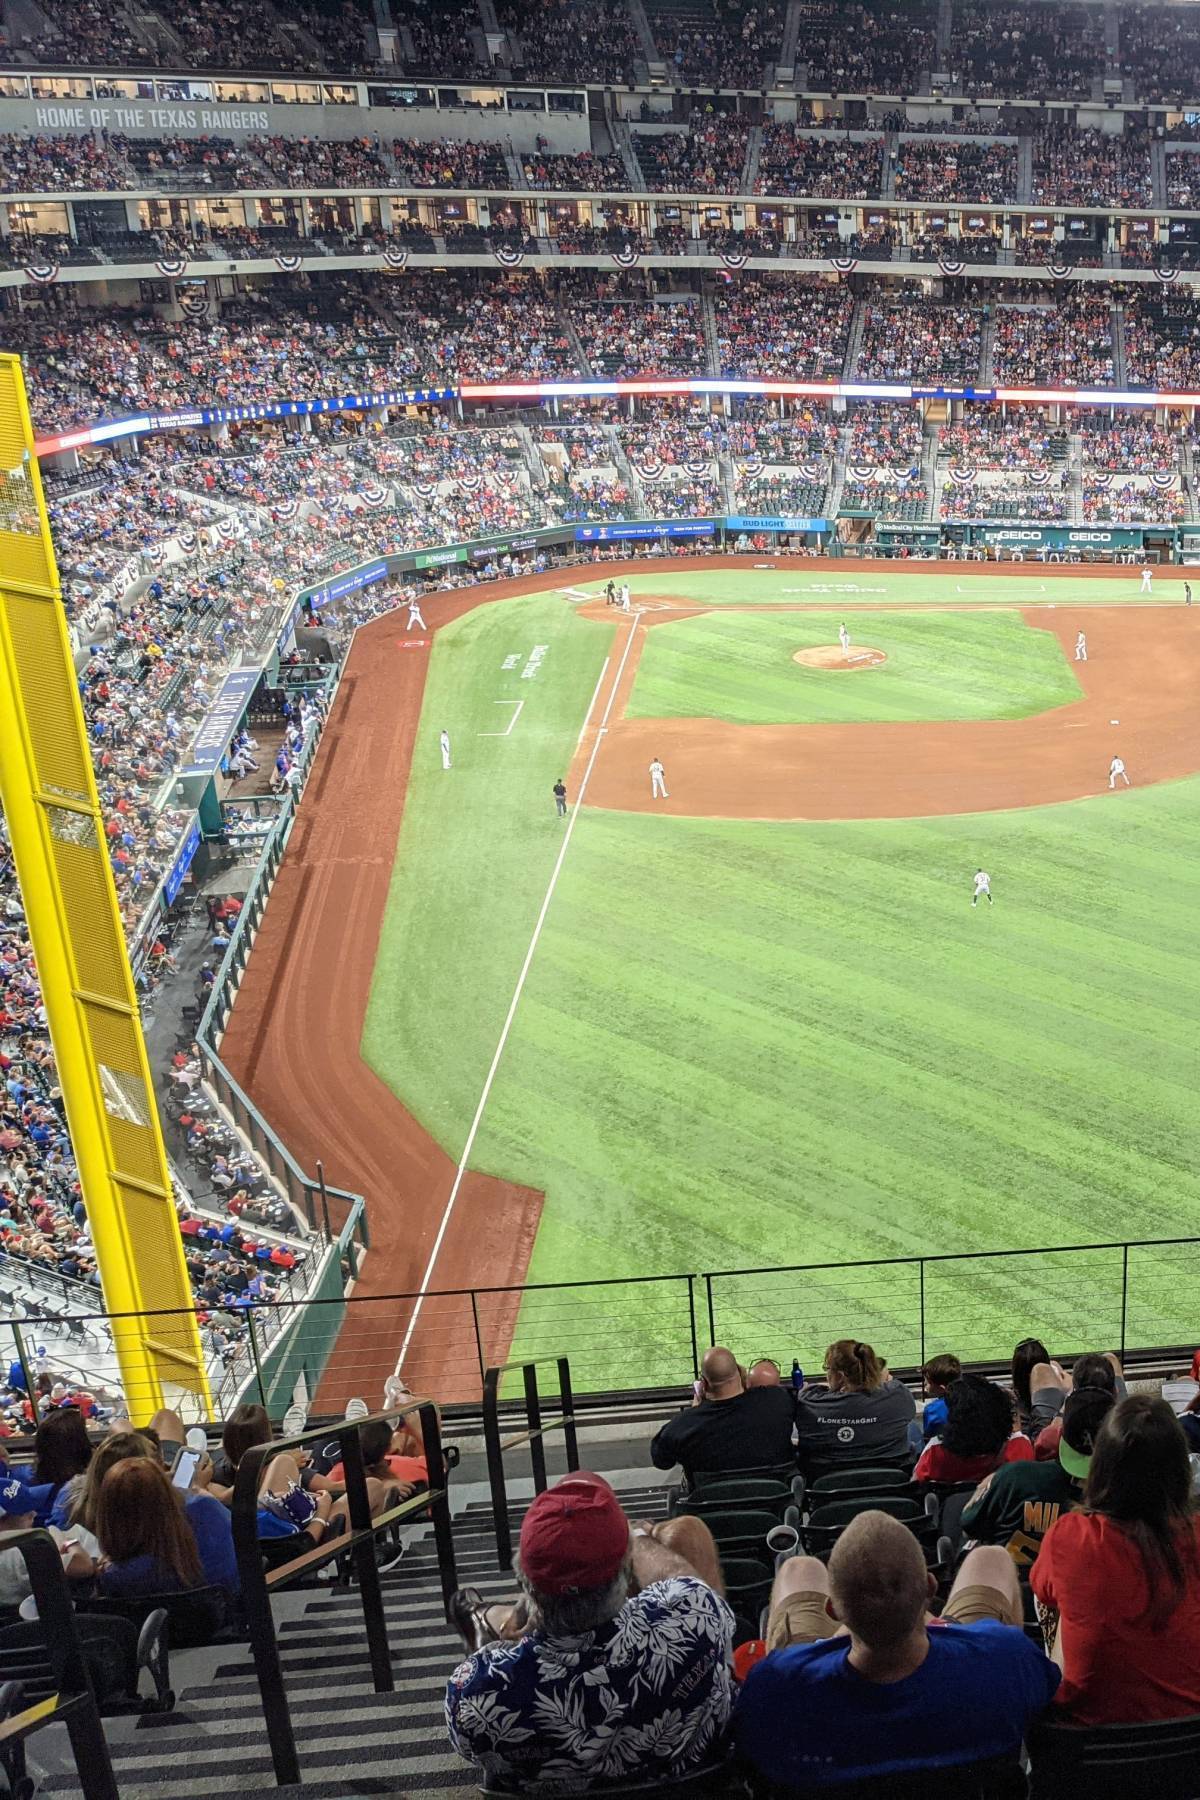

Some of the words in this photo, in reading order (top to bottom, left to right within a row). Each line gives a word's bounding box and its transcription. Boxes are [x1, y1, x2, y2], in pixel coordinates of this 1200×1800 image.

[36, 108, 85, 127] HOME
[91, 108, 110, 127] OF
[114, 109, 144, 127] THE
[148, 109, 197, 128] TEXAS
[202, 111, 268, 129] RANGERS
[761, 520, 785, 528] LIGHT
[1000, 531, 1041, 540] GEICO
[1069, 532, 1111, 541] GEICO
[432, 552, 457, 562] National
[214, 691, 246, 714] TEXAS
[196, 715, 235, 748] RANGERS
